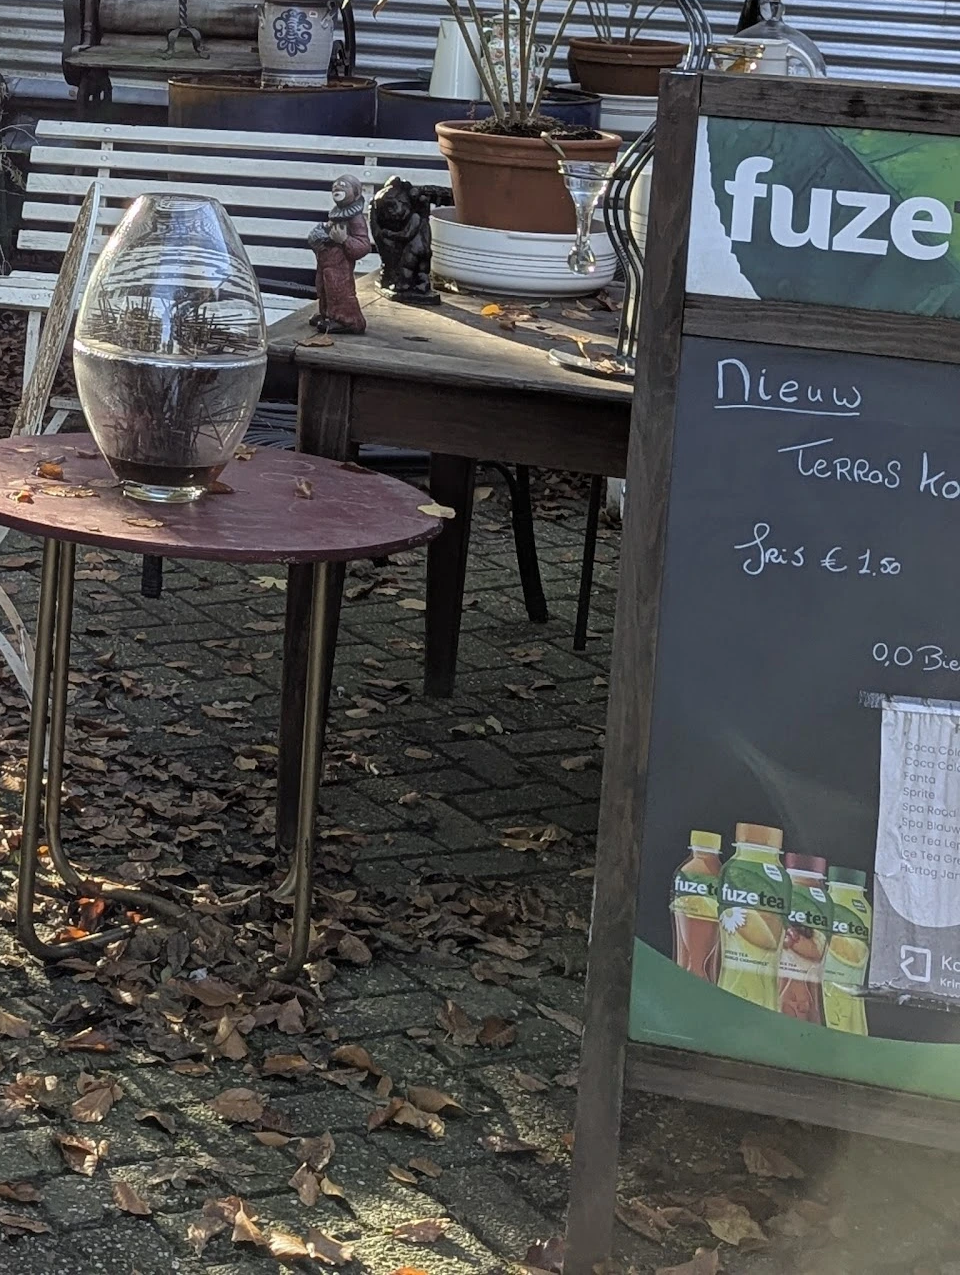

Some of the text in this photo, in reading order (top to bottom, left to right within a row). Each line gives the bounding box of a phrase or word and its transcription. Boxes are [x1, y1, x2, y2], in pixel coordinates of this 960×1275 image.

[724, 155, 960, 261] fuze
[904, 741, 936, 754] Coca
[904, 756, 935, 769] Coca
[903, 771, 936, 785] Fanta
[903, 787, 936, 800] Sprite
[902, 802, 956, 818] Spa Rood
[901, 817, 924, 829] Spa
[900, 832, 918, 844] Ice
[921, 835, 941, 846] Tea
[920, 850, 941, 862] Tea
[900, 863, 938, 880] Hertog
